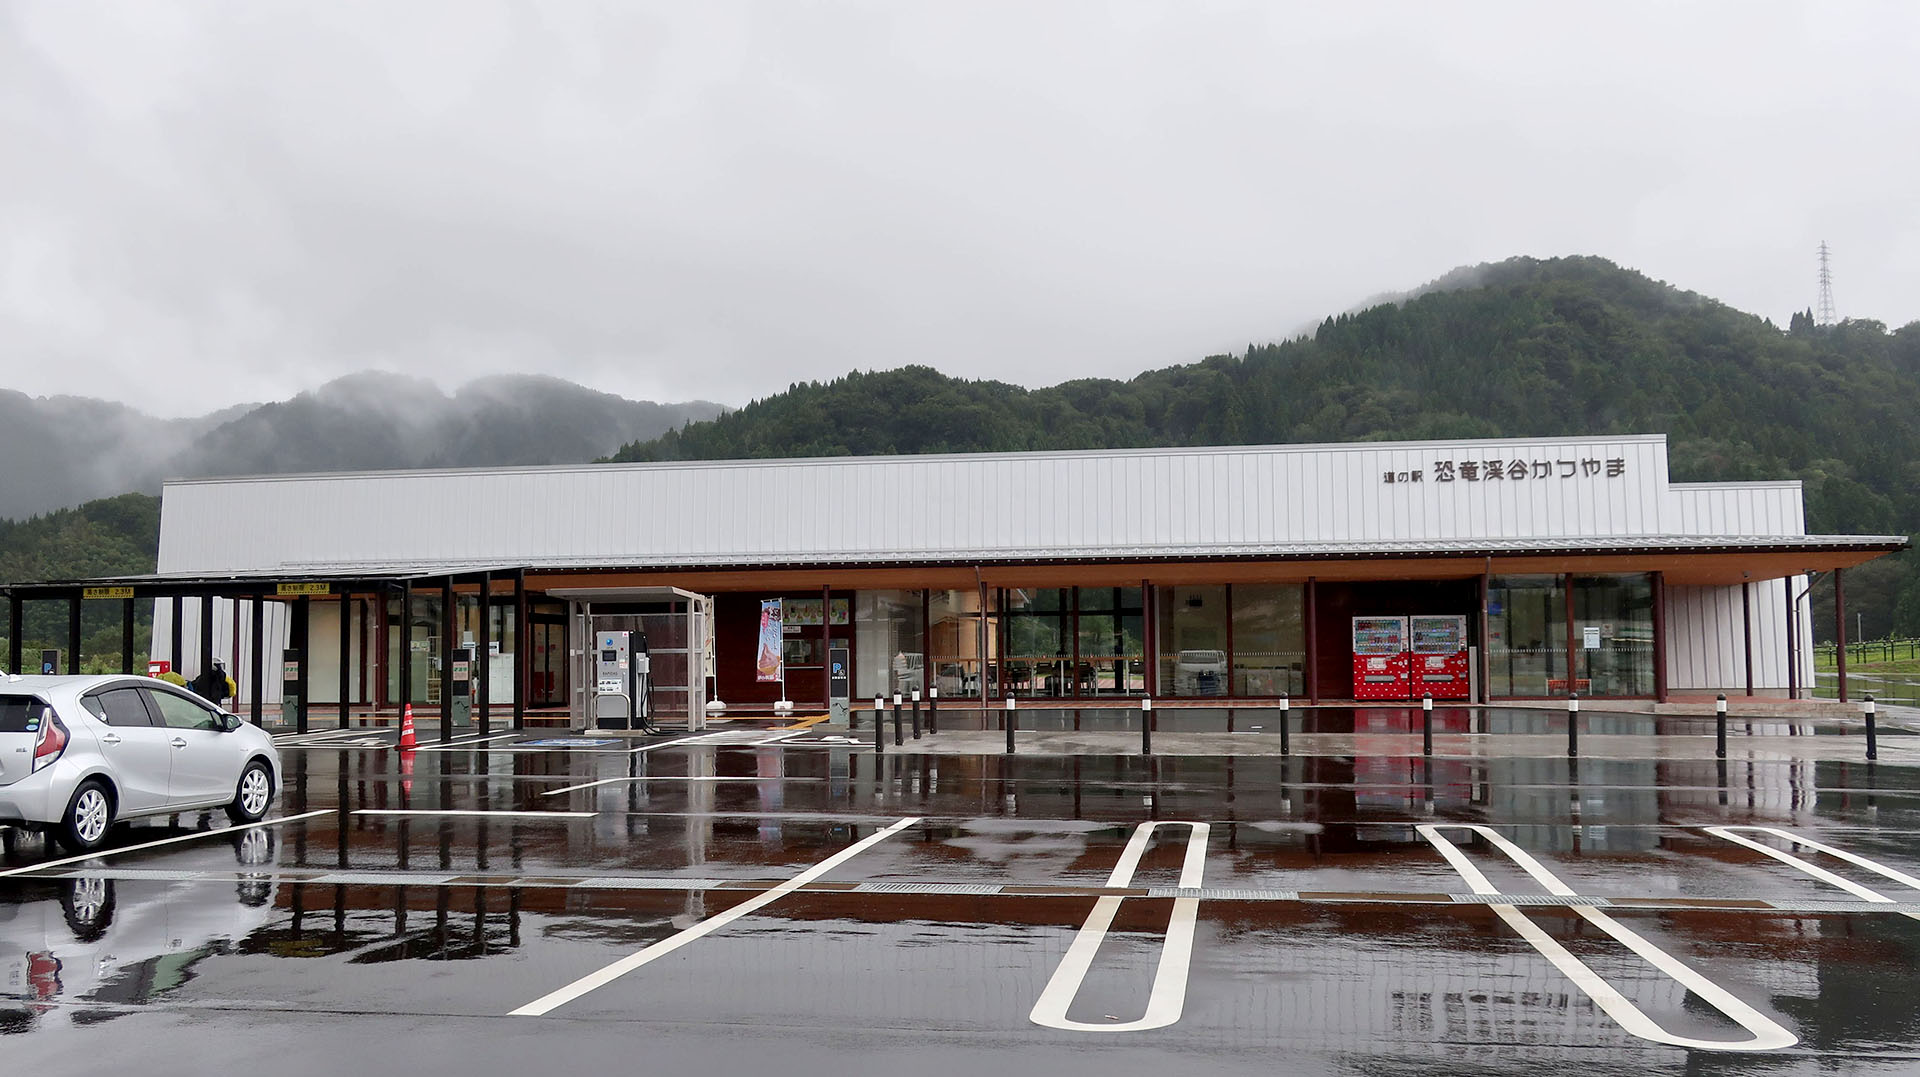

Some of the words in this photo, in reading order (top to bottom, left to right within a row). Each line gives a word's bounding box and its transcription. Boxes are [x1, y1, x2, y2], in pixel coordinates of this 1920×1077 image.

[1383, 470, 1423, 484] 道の駅
[1434, 457, 1626, 482] 恐竜渓谷かつやま
[833, 663, 842, 674] P
